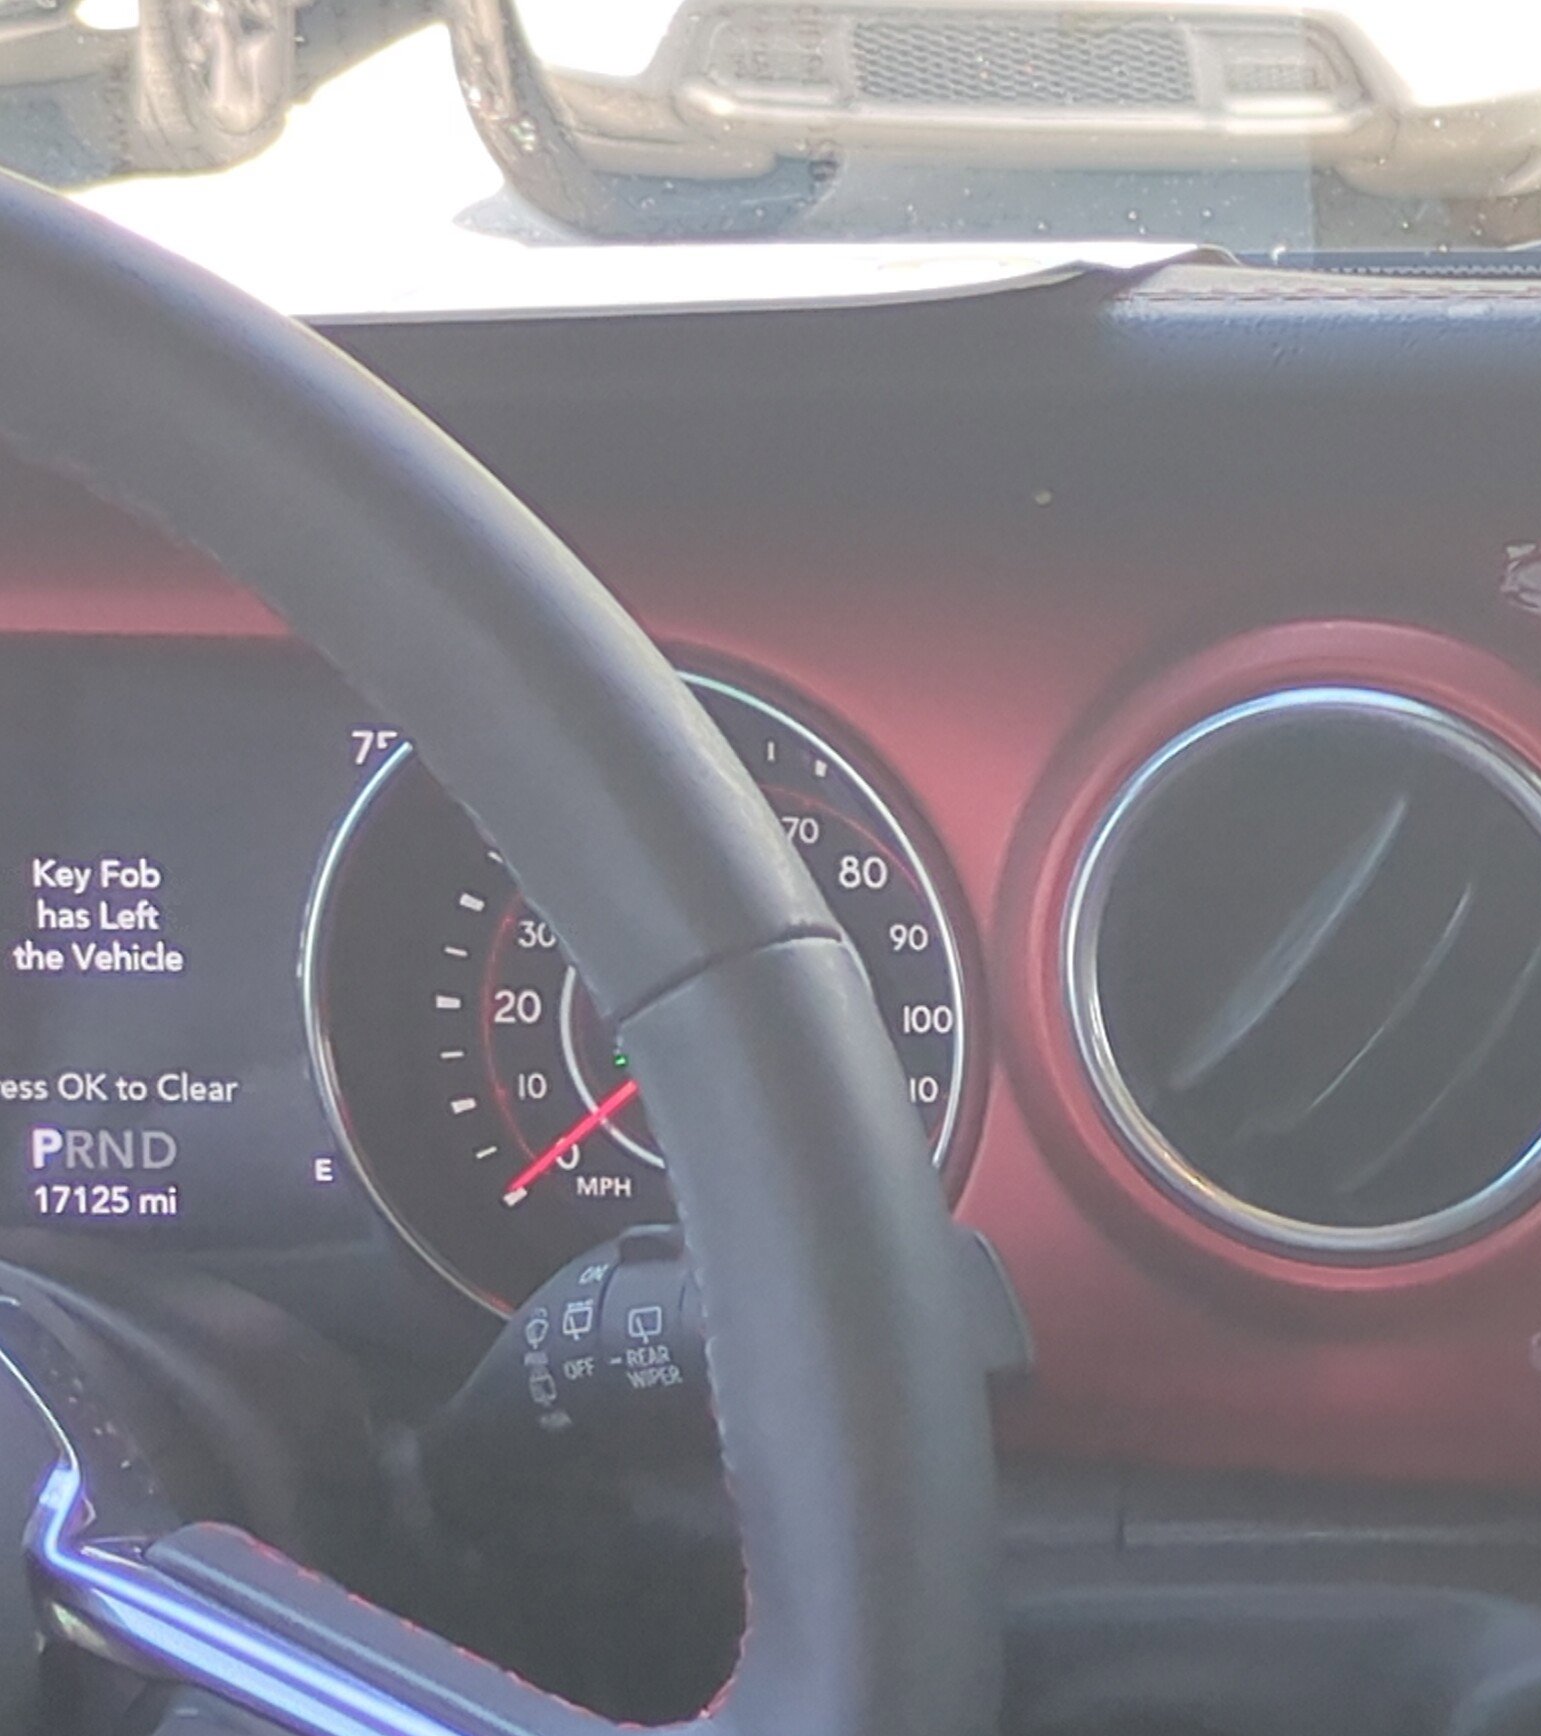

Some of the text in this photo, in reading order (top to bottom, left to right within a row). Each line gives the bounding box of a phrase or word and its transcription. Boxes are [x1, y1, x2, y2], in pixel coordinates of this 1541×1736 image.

[781, 817, 819, 844] 70
[32, 858, 161, 894] Key Fob
[839, 855, 887, 888] 80
[37, 898, 160, 930] has Left
[518, 920, 554, 948] 30
[890, 924, 928, 951] 90
[13, 939, 183, 972] the Vehicle
[494, 991, 541, 1023] 20
[903, 1005, 952, 1033] 100
[0, 1071, 238, 1102] ess OK to Clear
[519, 1073, 547, 1098] 10
[910, 1077, 938, 1102] 10
[315, 1158, 333, 1181] E
[35, 1185, 177, 1214] 17125 mi
[577, 1176, 631, 1197] MPH
[564, 1357, 595, 1380] OFF
[626, 1345, 670, 1367] REAR
[626, 1365, 682, 1388] WIPER
